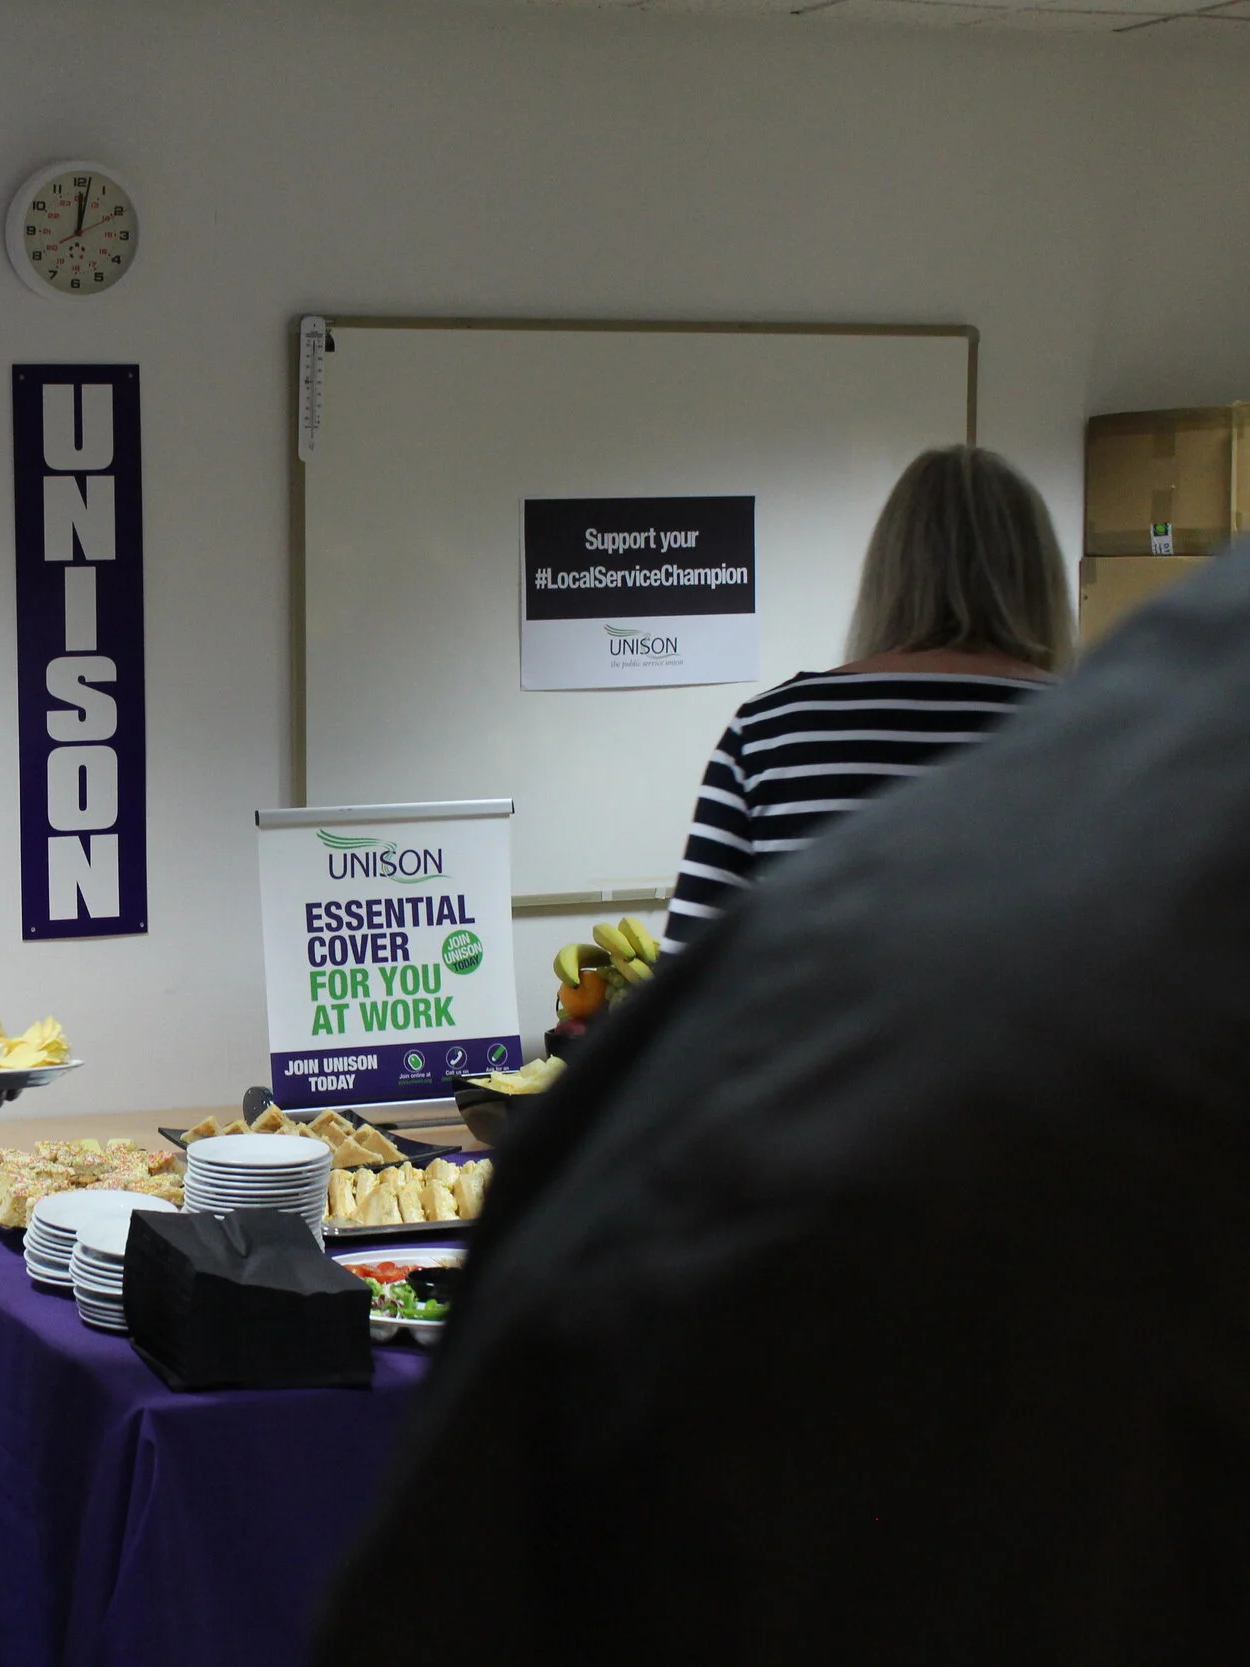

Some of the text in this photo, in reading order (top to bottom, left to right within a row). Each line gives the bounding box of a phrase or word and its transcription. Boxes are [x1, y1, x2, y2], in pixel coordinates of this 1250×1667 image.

[53, 184, 62, 194] 11
[73, 178, 87, 188] 12
[101, 185, 106, 196] 1
[32, 201, 46, 211] 10
[114, 206, 124, 216] 2
[26, 226, 37, 236] 9
[119, 231, 130, 241] 3
[32, 251, 42, 261] 8
[111, 255, 122, 265] 4
[48, 270, 58, 280] 7
[70, 279, 81, 289] 6
[93, 272, 104, 282] 5
[584, 528, 700, 554] Support your
[534, 563, 748, 590] #LocalServiceChampion
[42, 383, 120, 921] UNISON
[609, 638, 678, 656] UNISON
[328, 849, 443, 880] UNISON
[305, 894, 476, 933] ESSENTIAL
[307, 932, 411, 968] COVER
[446, 933, 470, 951] JOIN
[443, 942, 483, 966] UNISON
[451, 955, 480, 973] TODAY
[309, 963, 442, 1002] FOR YOU
[310, 996, 456, 1036] AT WORK
[284, 1055, 378, 1076] JOIN UNISON
[308, 1074, 356, 1092] TODAY
